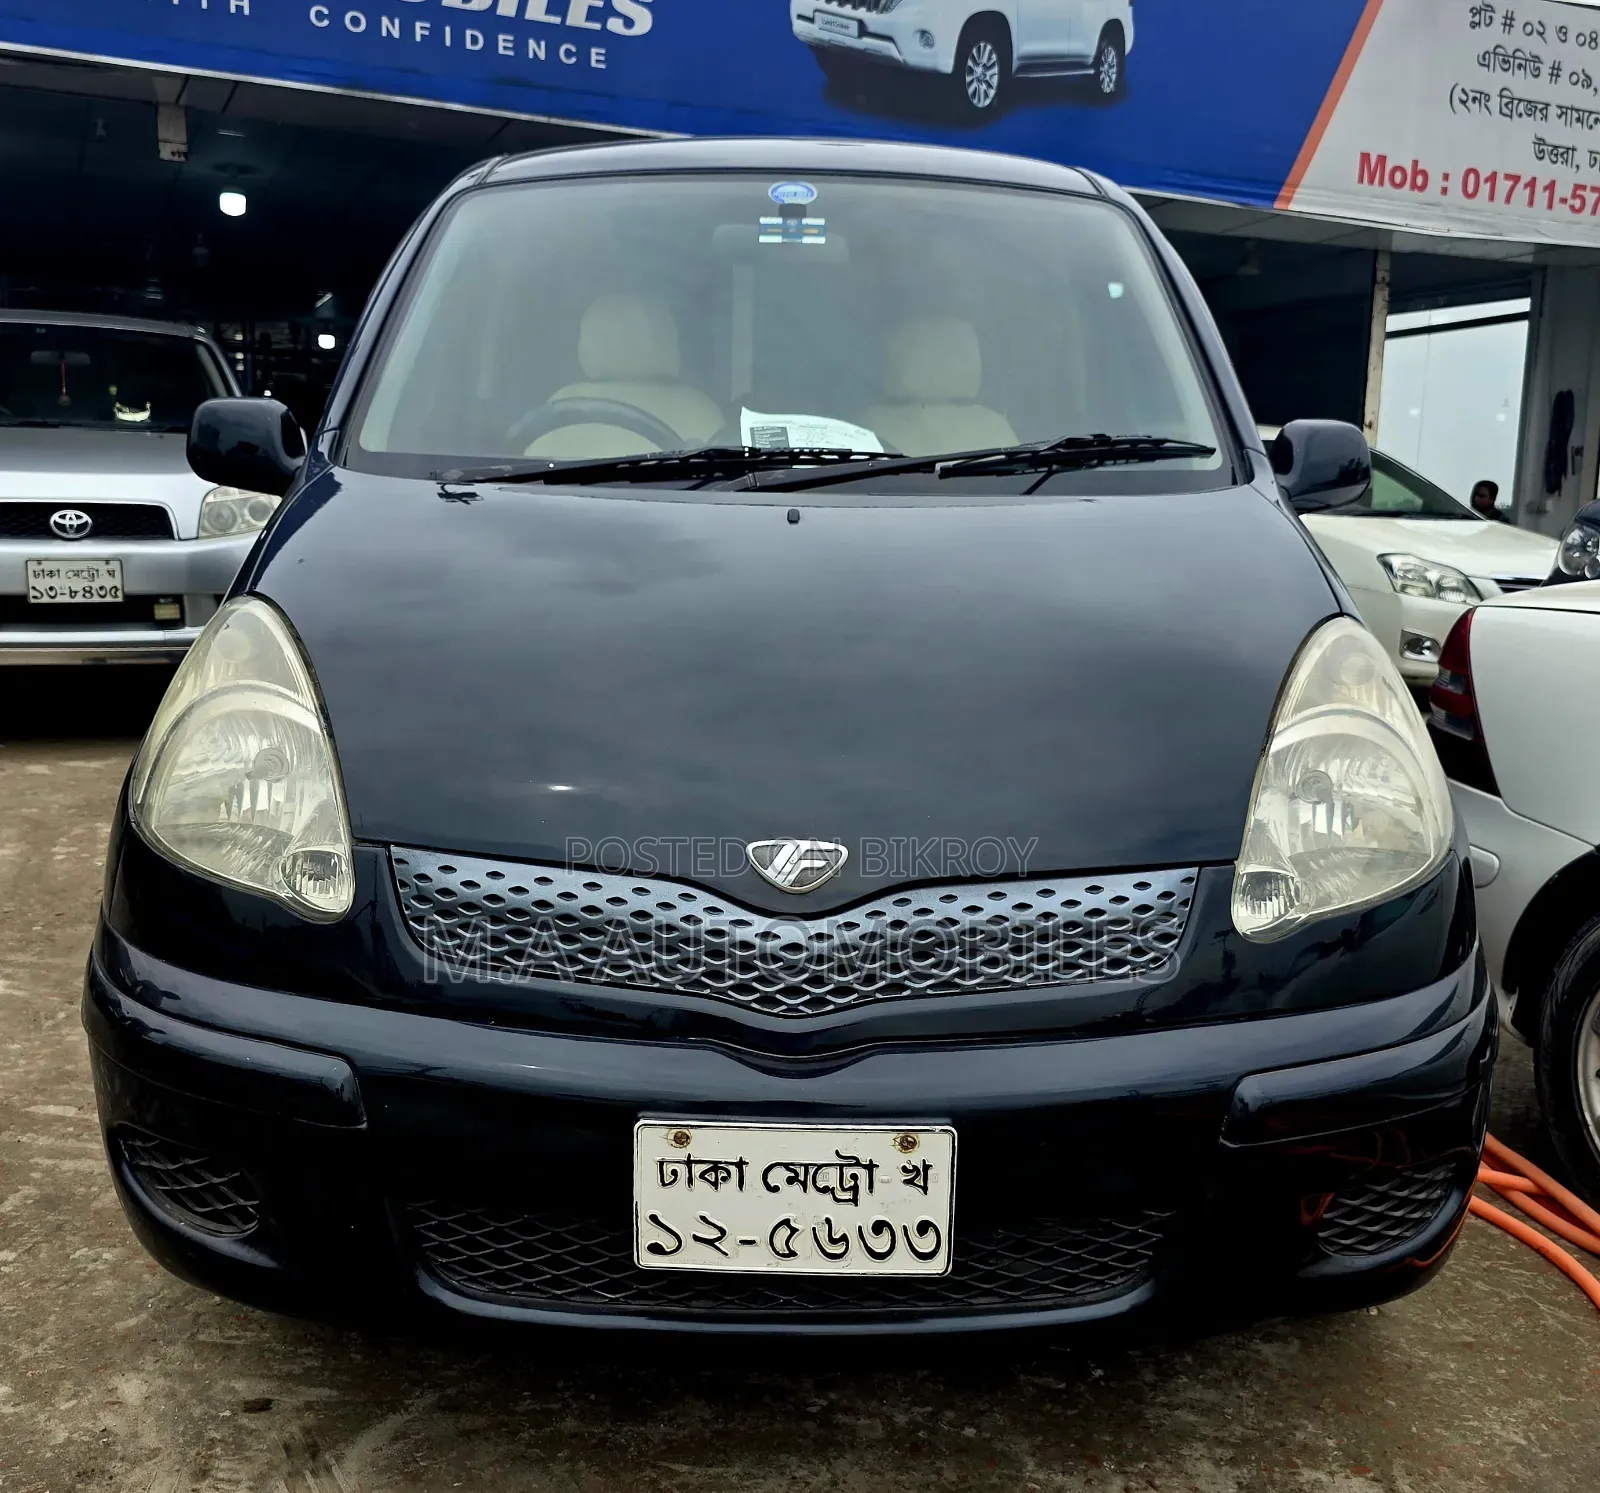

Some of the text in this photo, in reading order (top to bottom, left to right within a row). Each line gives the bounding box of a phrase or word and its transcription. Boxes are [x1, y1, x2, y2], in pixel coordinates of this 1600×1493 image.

[309, 5, 607, 69] CONFIDENCE
[1469, 0, 1598, 50] প্লট # ০২ ও ০৪
[1477, 44, 1598, 97] এভিনিউ # ০৯,
[1449, 82, 1492, 116] (২নং
[1497, 86, 1551, 122] ব্রিজের
[1532, 133, 1580, 174] উত্তরা,
[1357, 152, 1429, 193] Mob
[1461, 167, 1600, 217] 01711-57
[31, 585, 121, 600] ১৩-৮৪৩৫
[33, 568, 61, 579] ঢাকা
[655, 1149, 933, 1207] ঢাকা মেট্রো খ
[646, 1213, 943, 1261] ১২-৫৬৩৩
